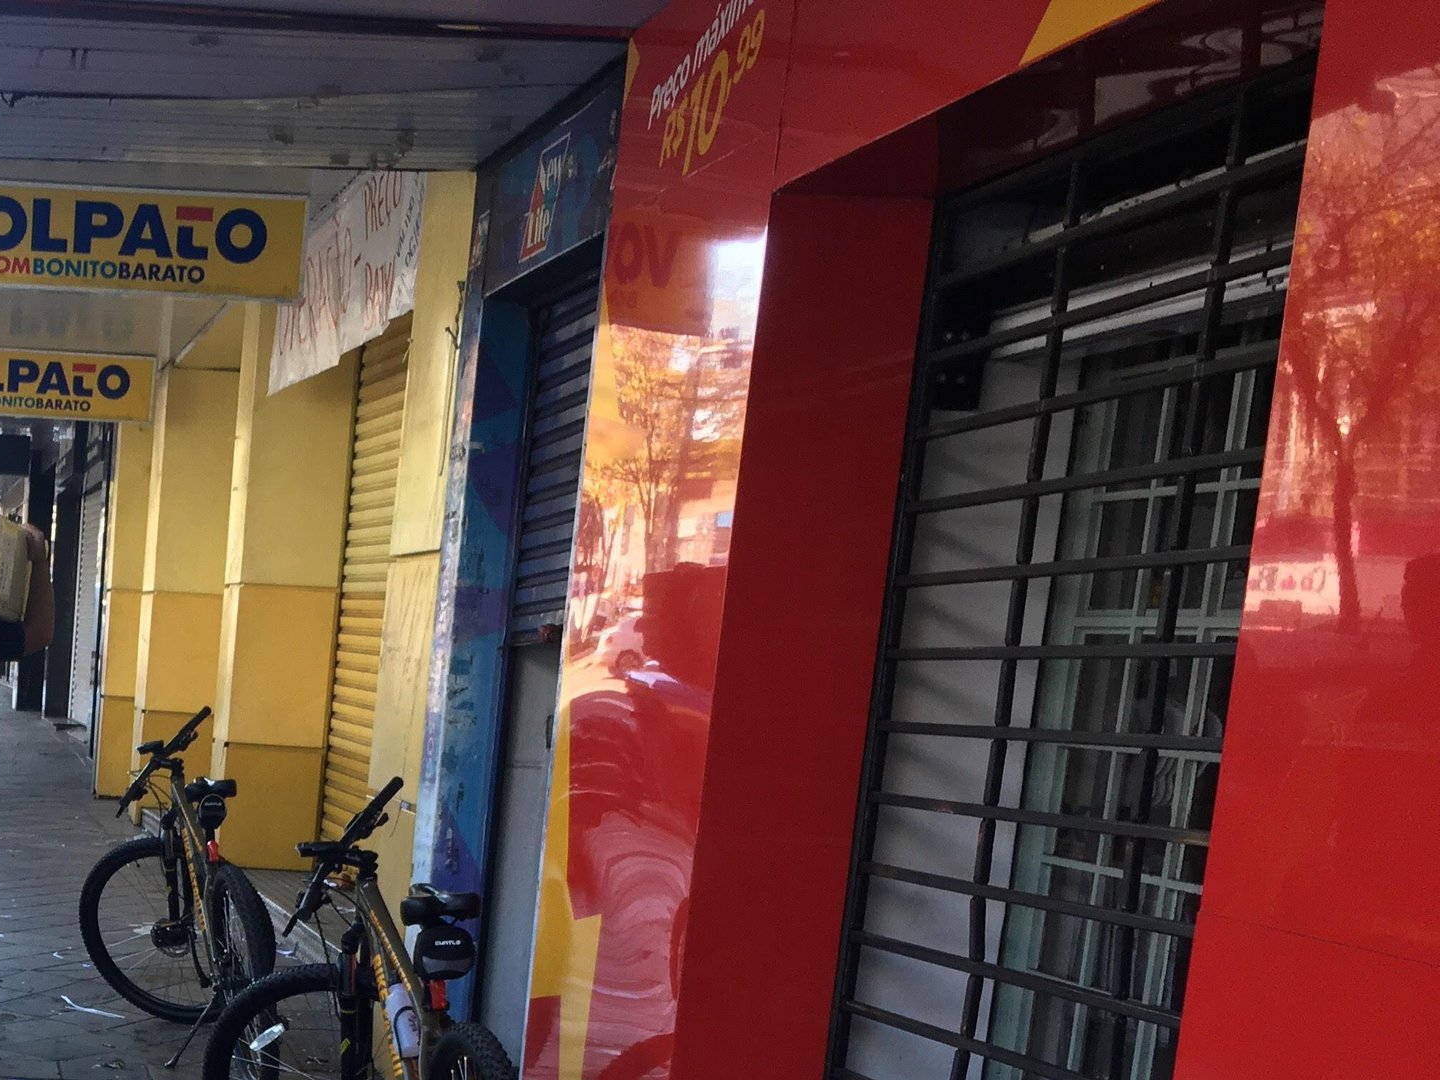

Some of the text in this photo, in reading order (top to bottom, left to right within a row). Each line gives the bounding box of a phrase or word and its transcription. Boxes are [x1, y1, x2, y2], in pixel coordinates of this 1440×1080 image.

[692, 0, 753, 76] máxim
[526, 204, 550, 249] Life
[371, 953, 389, 1000] BIKE
